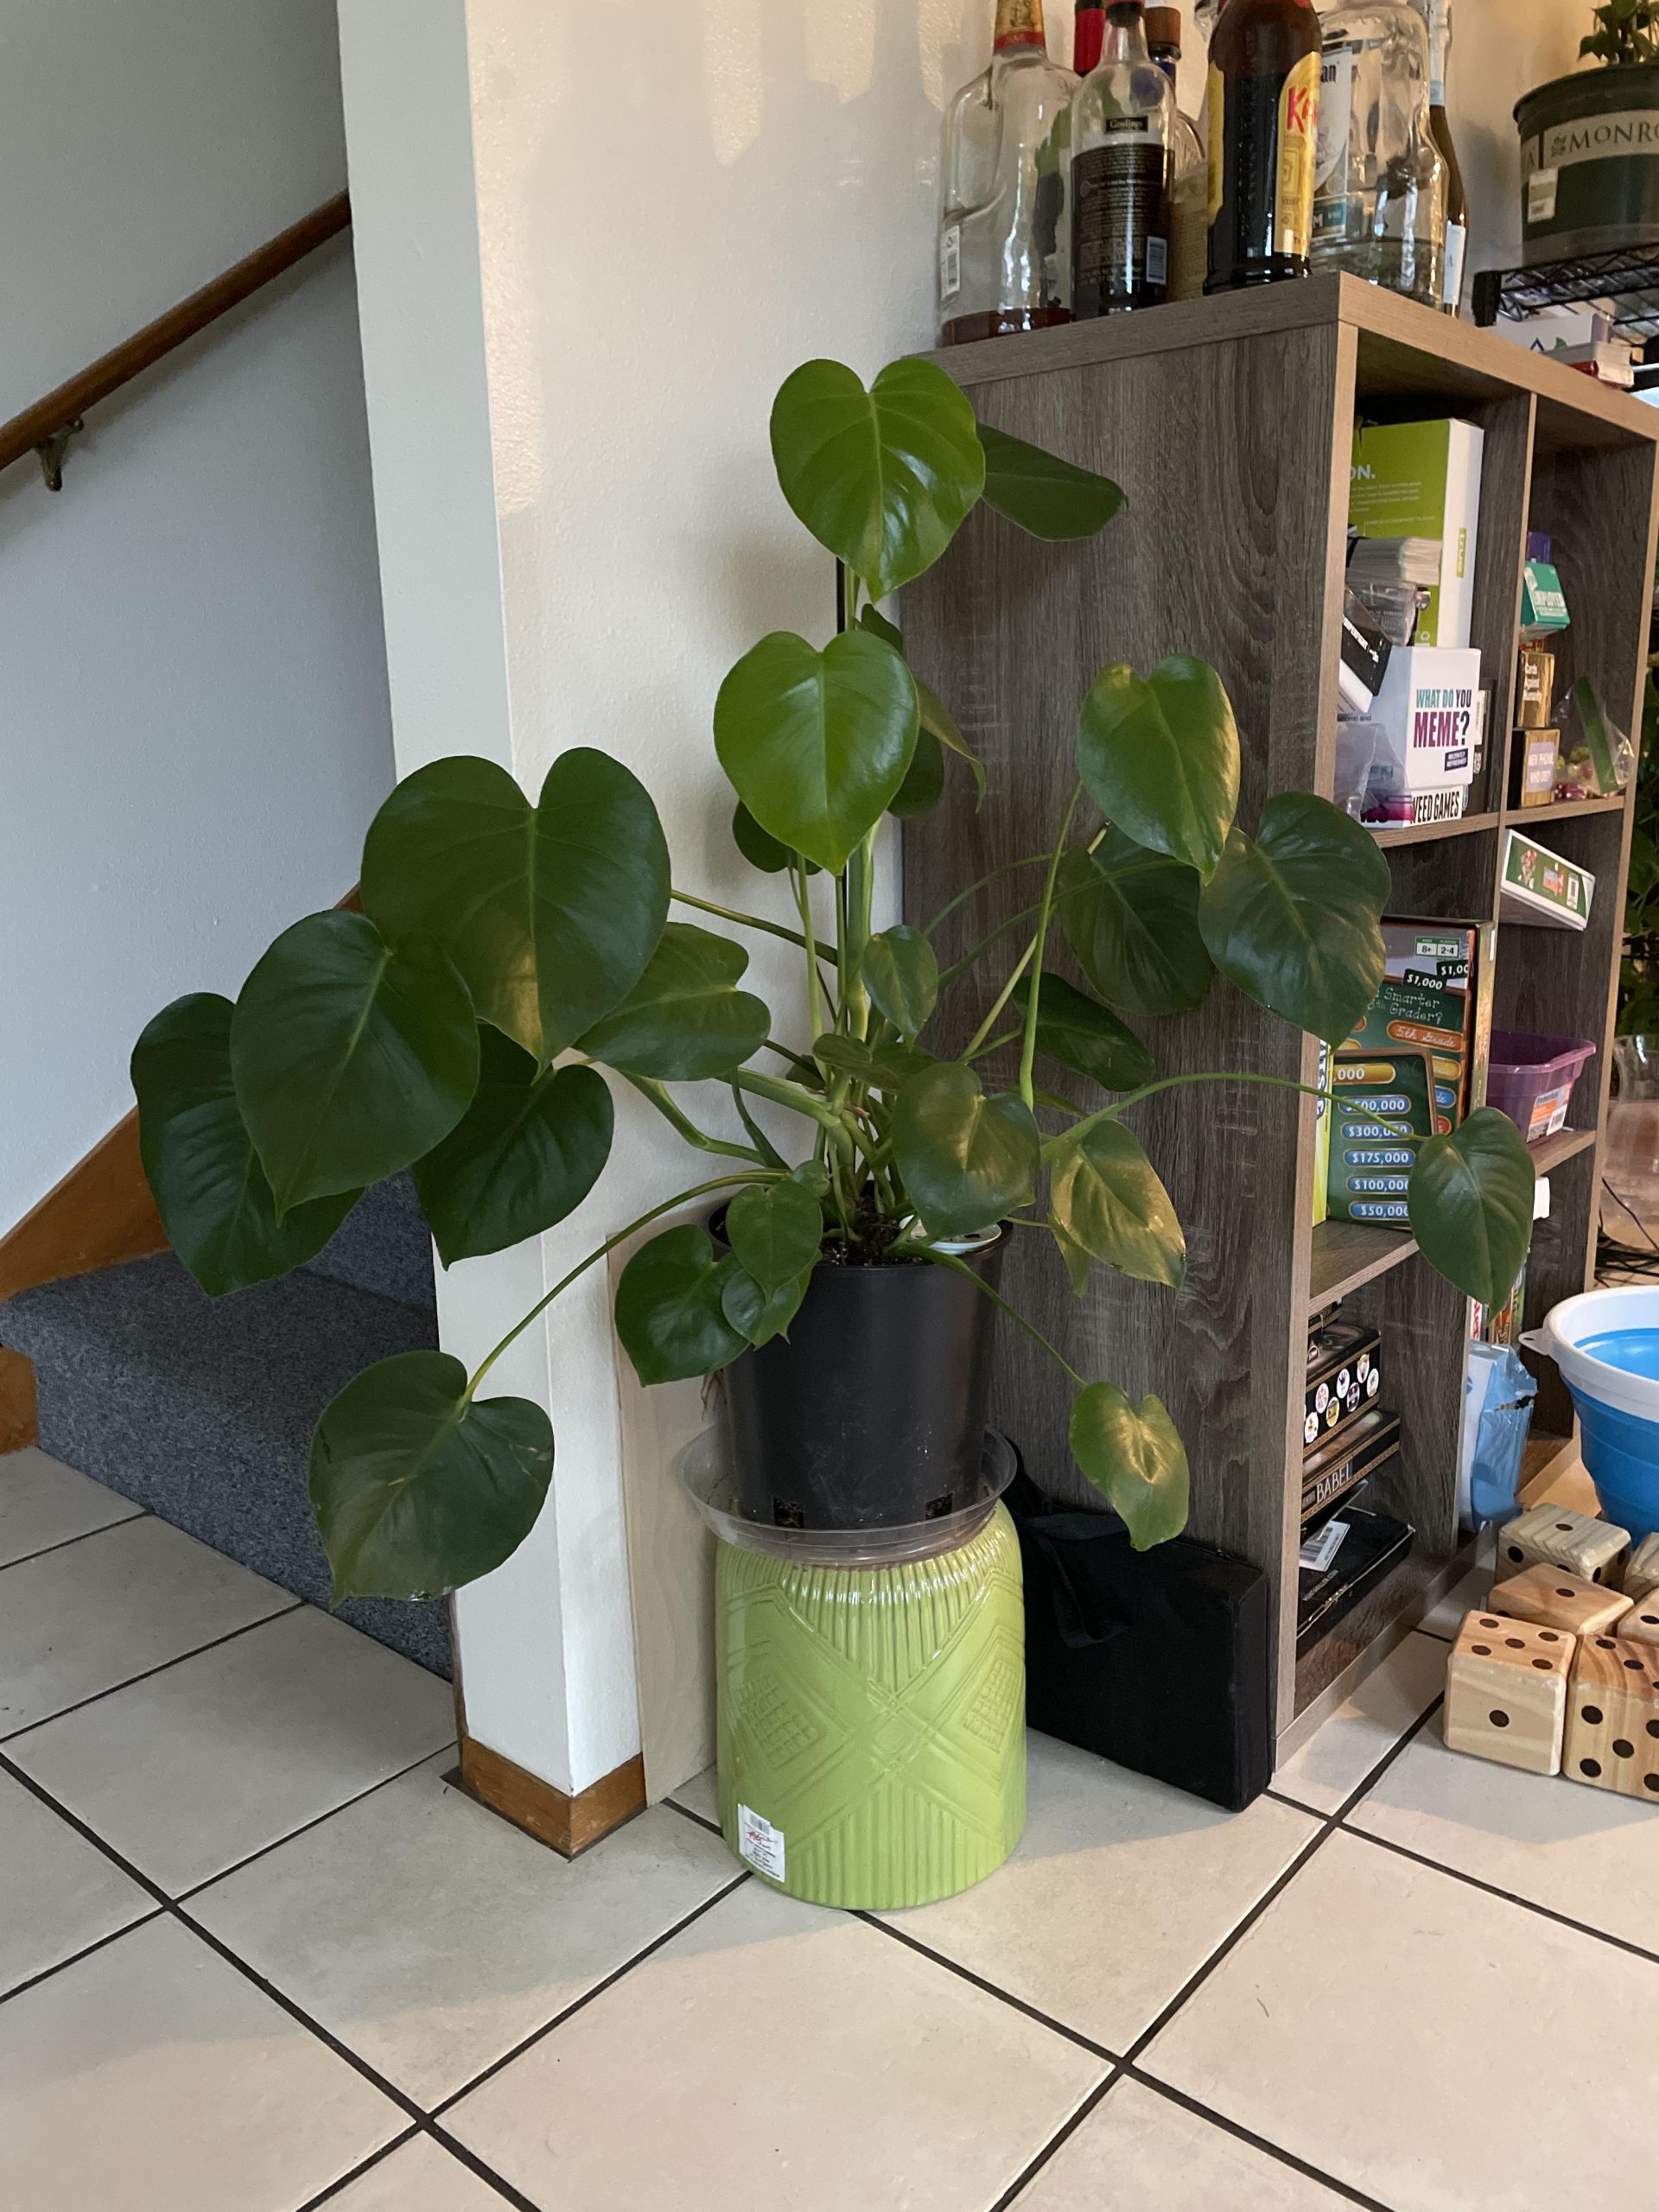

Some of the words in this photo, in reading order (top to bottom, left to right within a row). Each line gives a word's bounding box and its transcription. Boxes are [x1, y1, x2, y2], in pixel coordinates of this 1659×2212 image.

[1415, 689, 1441, 709] WHAT
[1442, 689, 1454, 709] DO
[1456, 689, 1472, 709] YOU
[1413, 710, 1470, 748] MEME?
[1433, 791, 1460, 821] GAMES
[1421, 945, 1432, 954] 8+
[1440, 946, 1454, 955] 2-4
[1407, 974, 1443, 990] $1,000
[1383, 987, 1440, 1009] Smarter
[1389, 1002, 1443, 1026] Grader?
[1352, 1152, 1409, 1165] $175,000
[1316, 1462, 1354, 1504] BABEL
